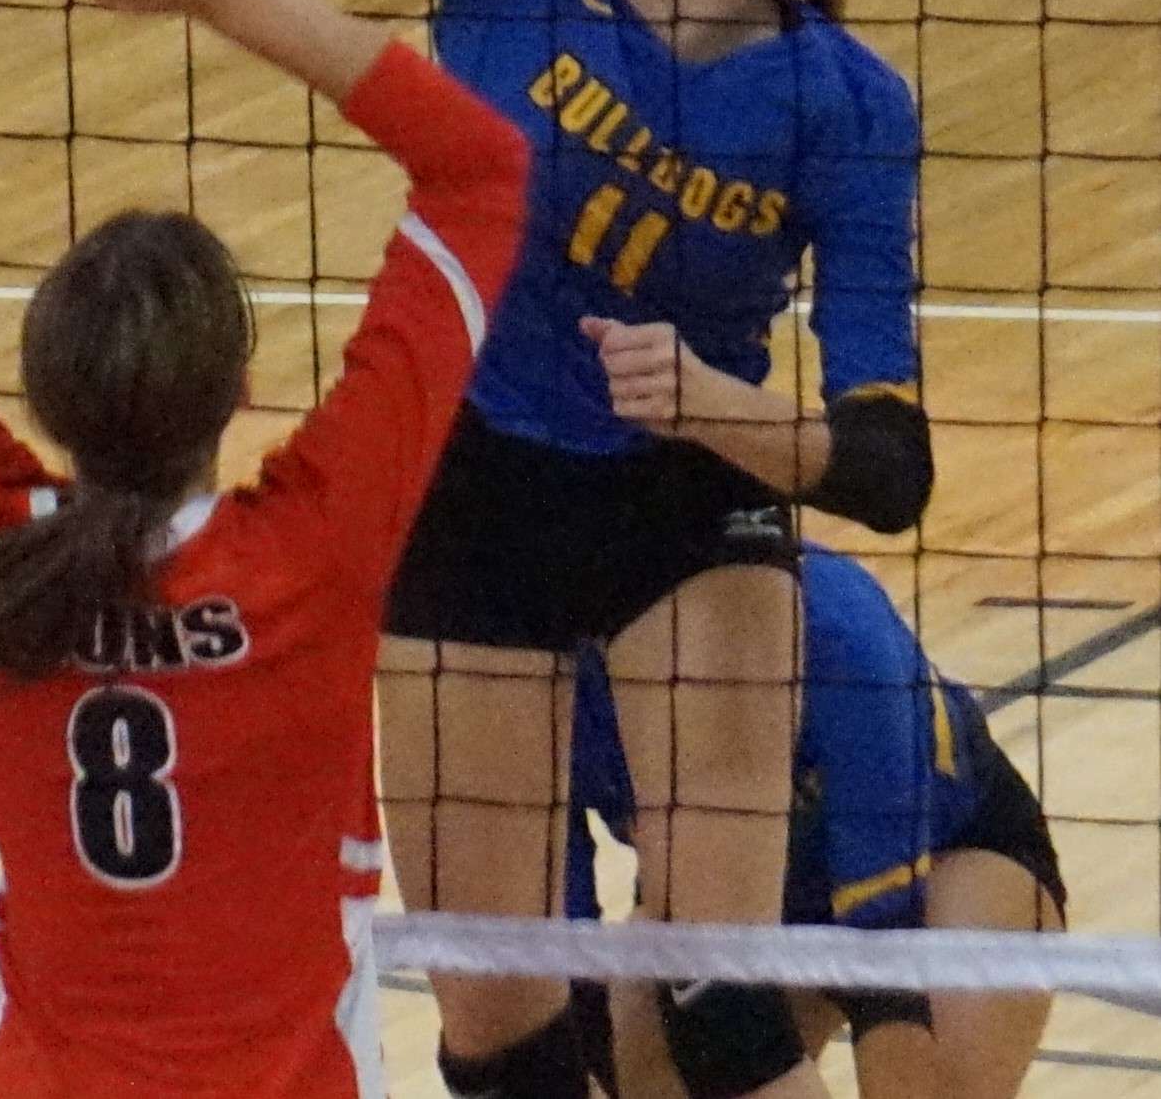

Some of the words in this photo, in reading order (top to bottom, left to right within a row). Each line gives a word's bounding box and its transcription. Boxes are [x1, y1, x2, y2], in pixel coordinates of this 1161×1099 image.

[529, 53, 789, 236] BULLDOGS
[567, 184, 671, 295] 11
[66, 683, 185, 891] 8
